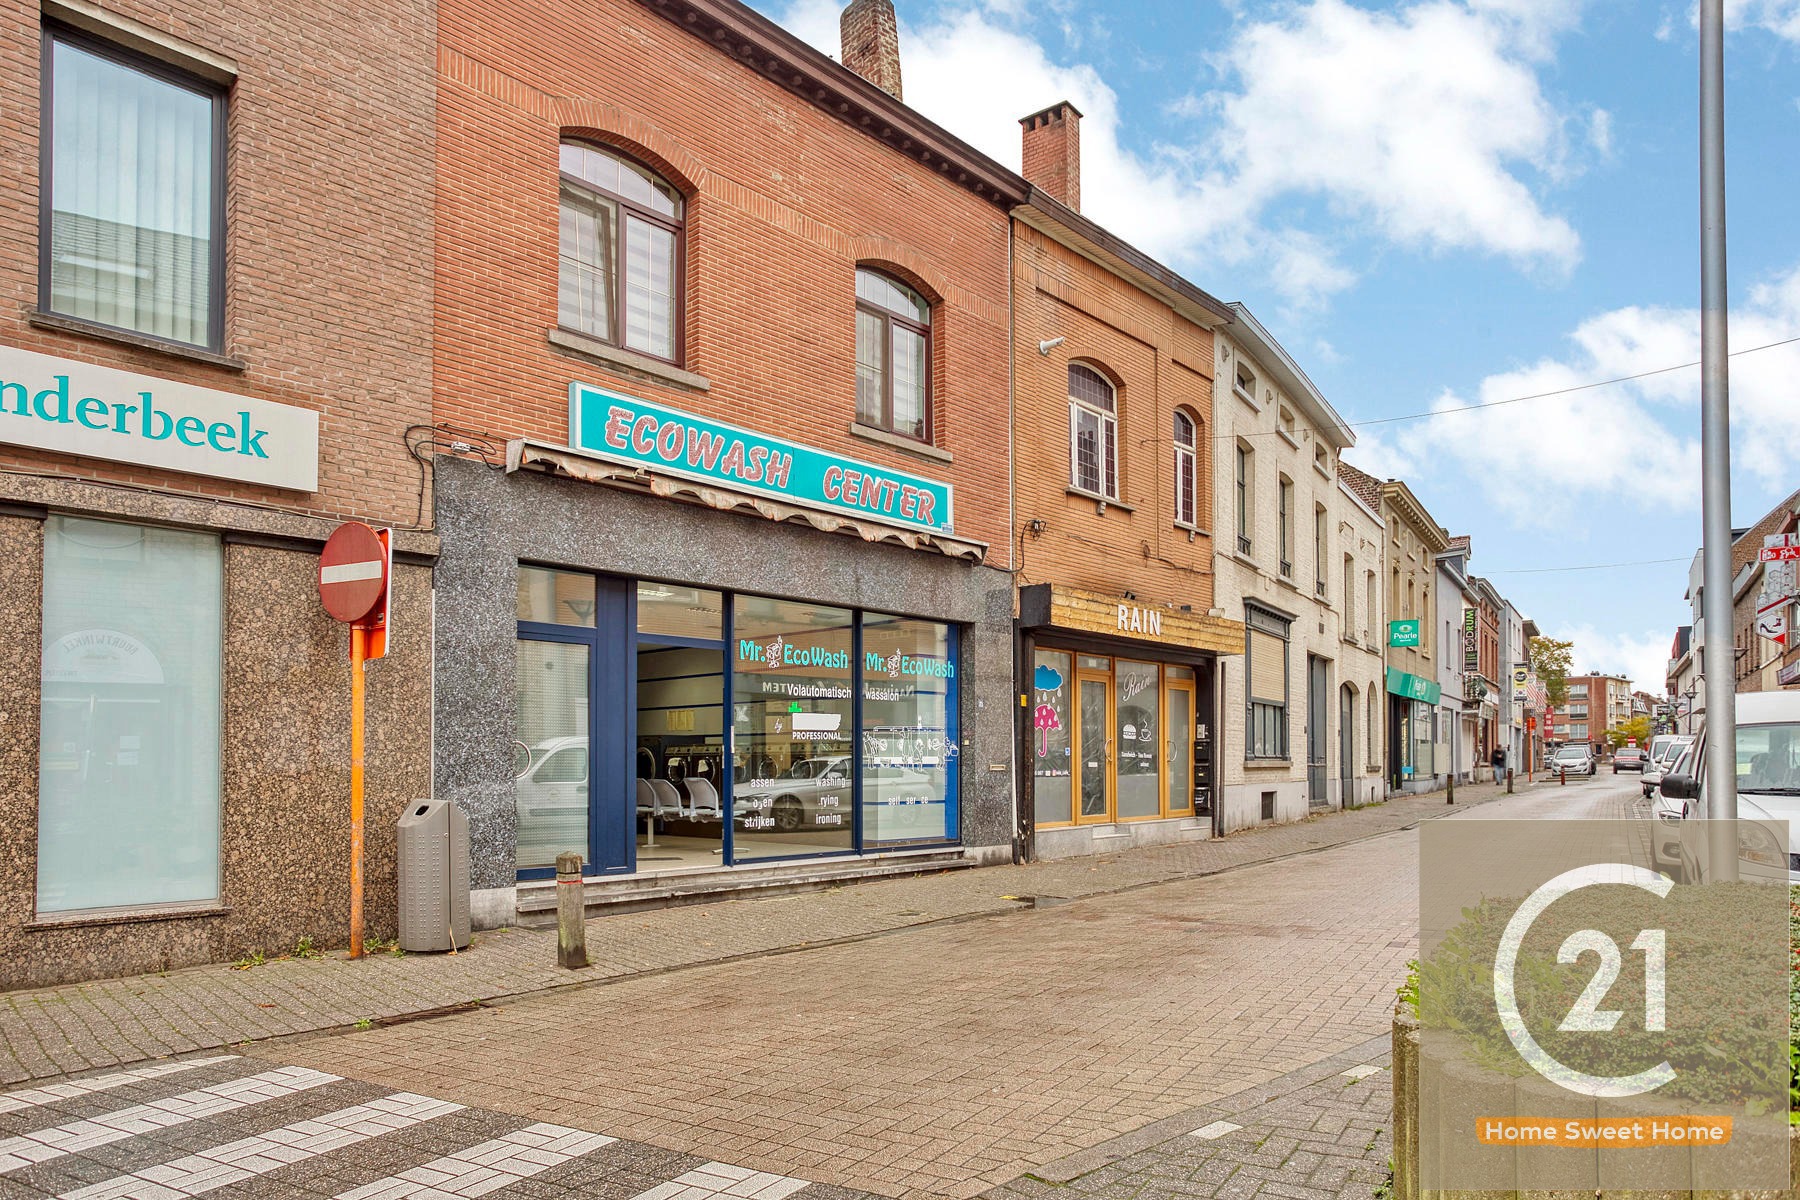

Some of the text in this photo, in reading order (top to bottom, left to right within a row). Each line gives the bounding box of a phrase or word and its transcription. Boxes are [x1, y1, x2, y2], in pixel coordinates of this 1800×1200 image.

[0, 376, 270, 459] nderbeek
[604, 406, 936, 525] ECOWASH CENTER
[1117, 604, 1161, 636] RAIN
[1465, 609, 1475, 652] BODRUM
[1393, 631, 1418, 640] Pearle
[740, 640, 848, 670] Mr. EcoWash
[866, 652, 955, 679] Mr. EcoWash
[787, 683, 852, 700] Volautomatisch
[865, 689, 899, 702] wassalon
[1122, 671, 1152, 702] Rain
[792, 731, 842, 741] PROFESSIONAL
[815, 776, 846, 788] washing
[744, 815, 775, 829] strijken
[815, 813, 842, 825] ironing
